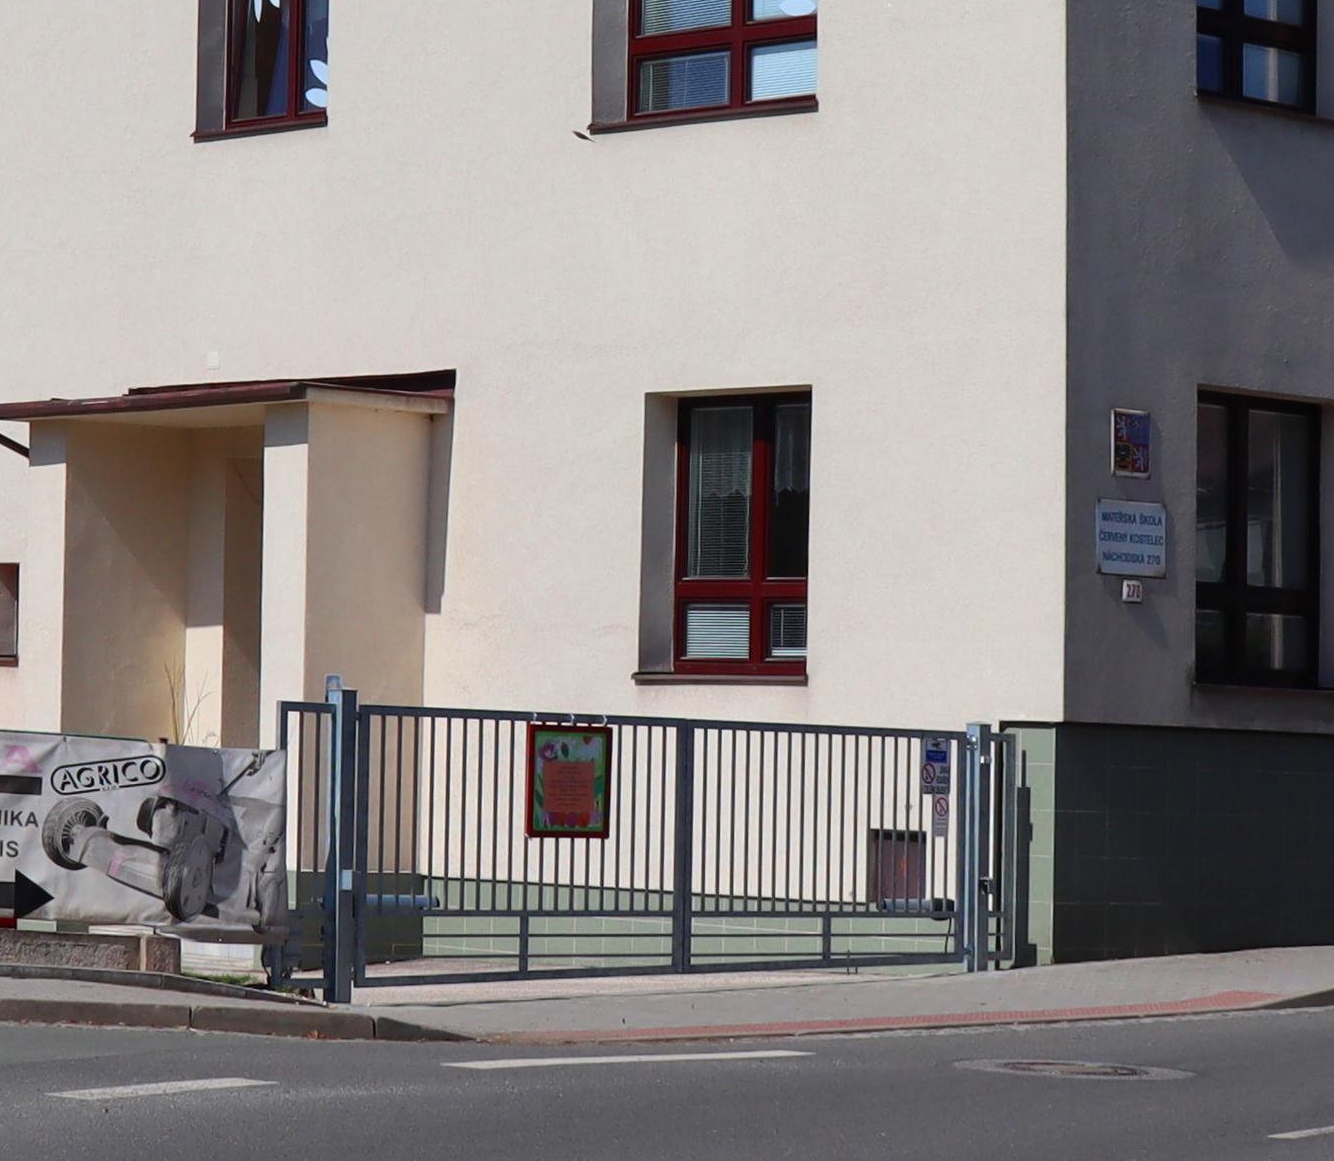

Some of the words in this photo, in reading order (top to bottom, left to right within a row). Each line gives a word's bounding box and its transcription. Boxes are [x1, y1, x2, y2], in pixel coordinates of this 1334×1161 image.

[1101, 511, 1136, 524] MATEŘSKÁ
[1139, 513, 1162, 526] ŠKOLA
[1099, 529, 1128, 542] ČERVENÝ
[1129, 533, 1164, 546] KOSTELEC
[1102, 550, 1144, 564] NÁCHODSKÁ
[1147, 555, 1160, 565] 270
[1126, 584, 1140, 598] 270
[60, 758, 162, 792] AGRICO
